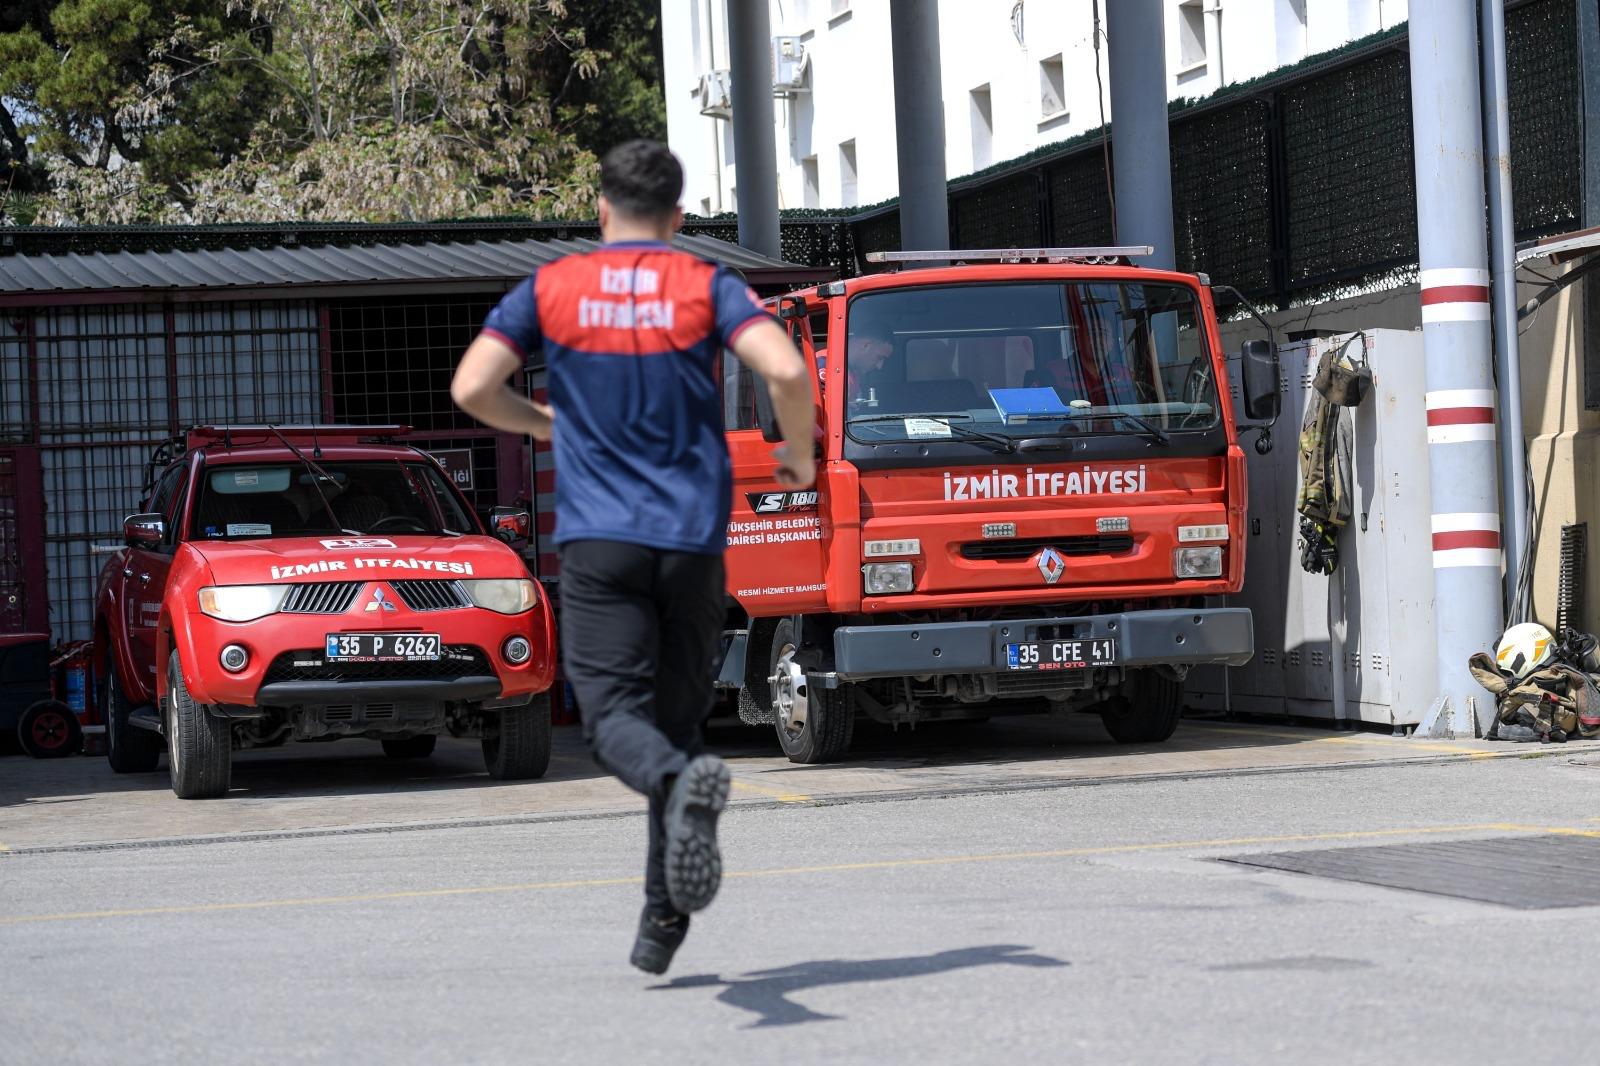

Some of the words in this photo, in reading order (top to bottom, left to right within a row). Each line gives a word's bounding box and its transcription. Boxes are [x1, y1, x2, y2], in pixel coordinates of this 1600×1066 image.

[453, 469, 470, 483] İĞİ
[944, 469, 1019, 501] İZMİR
[1026, 464, 1146, 497] İTFAİYESİ
[727, 533, 765, 547] DAİRESİ
[270, 560, 347, 580] İZMİR
[354, 557, 474, 576] İTFAİYESİ
[737, 586, 761, 597] RESMİ
[762, 584, 795, 596] HİZMETE
[795, 583, 827, 593] MAHSUS
[339, 636, 360, 656] 35
[373, 637, 384, 656] P
[394, 637, 436, 656] 6262
[1019, 644, 1040, 664] 35
[1052, 642, 1082, 662] CFE
[1092, 641, 1110, 660] 41
[1038, 663, 1061, 671] SEN
